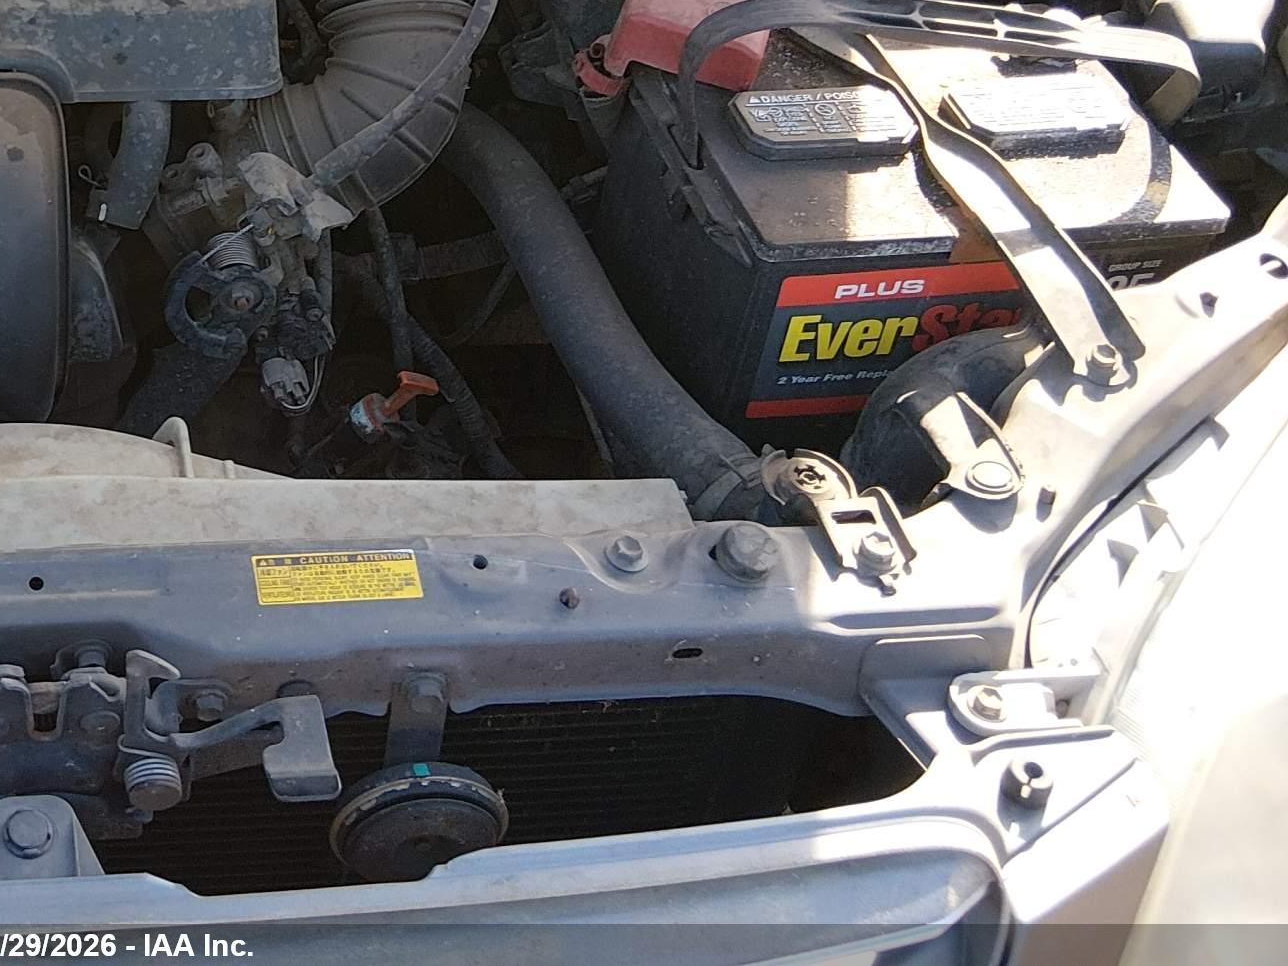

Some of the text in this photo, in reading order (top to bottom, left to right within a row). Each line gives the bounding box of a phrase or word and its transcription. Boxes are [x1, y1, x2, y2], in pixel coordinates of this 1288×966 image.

[760, 94, 813, 104] DANGER
[823, 91, 862, 101] POISO
[834, 279, 926, 299] PLUS
[778, 302, 1022, 363] EverSta
[777, 369, 889, 384] 2 Year Free Repl
[299, 556, 349, 564] CAUTION
[357, 553, 410, 562] ATTENTION
